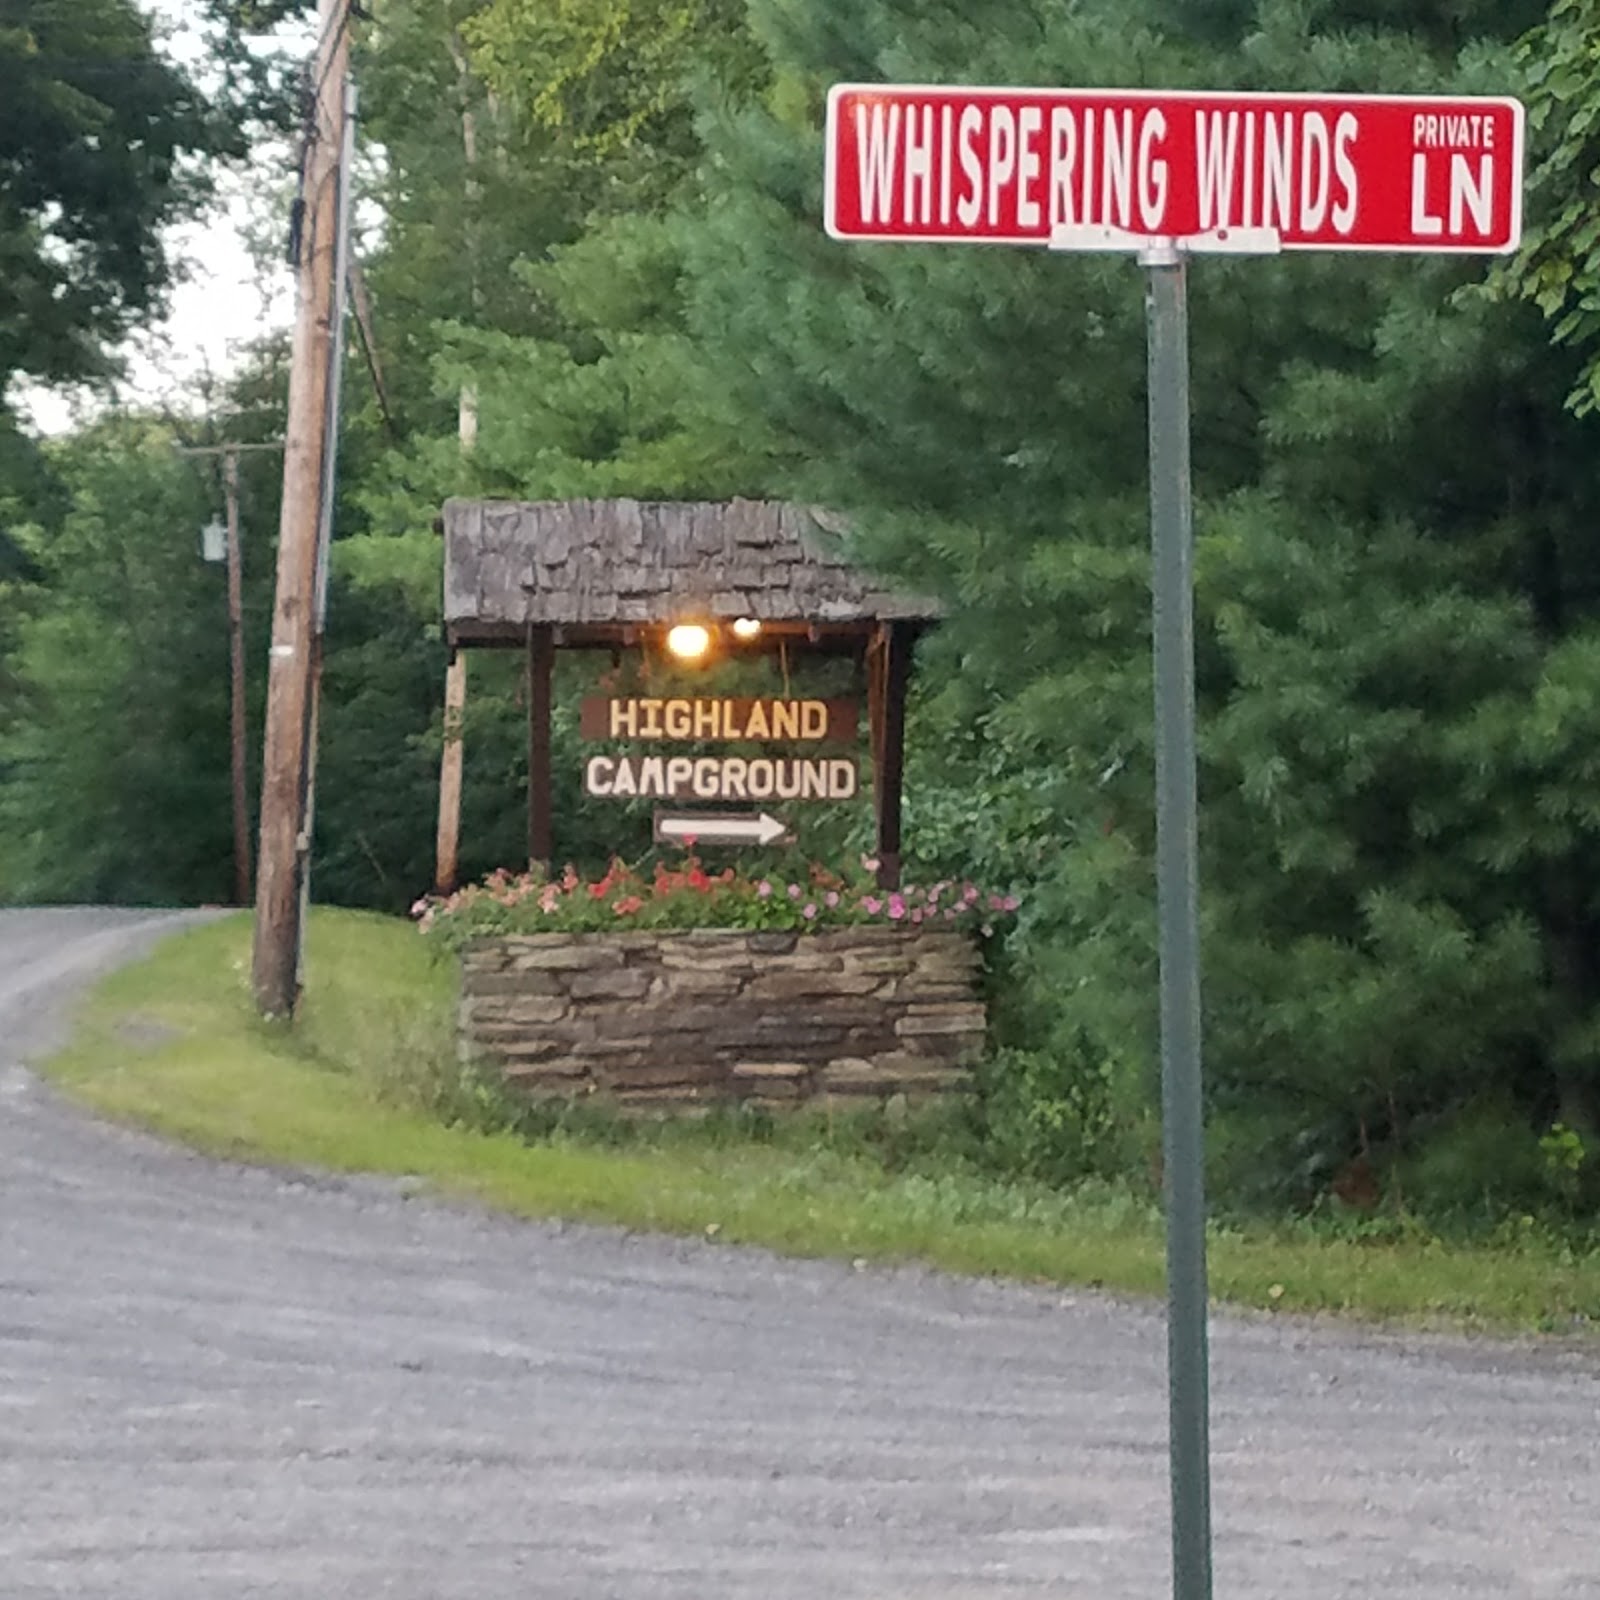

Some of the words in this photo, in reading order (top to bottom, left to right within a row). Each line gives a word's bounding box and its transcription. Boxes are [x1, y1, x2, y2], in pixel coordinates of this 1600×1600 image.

[1412, 114, 1495, 149] PRIVATE
[855, 103, 1168, 230] WHISPERING
[1195, 109, 1358, 235] WINDS
[1410, 152, 1494, 236] LN
[609, 698, 828, 740] HIGHLAND
[586, 756, 856, 799] CAMPGROUND
